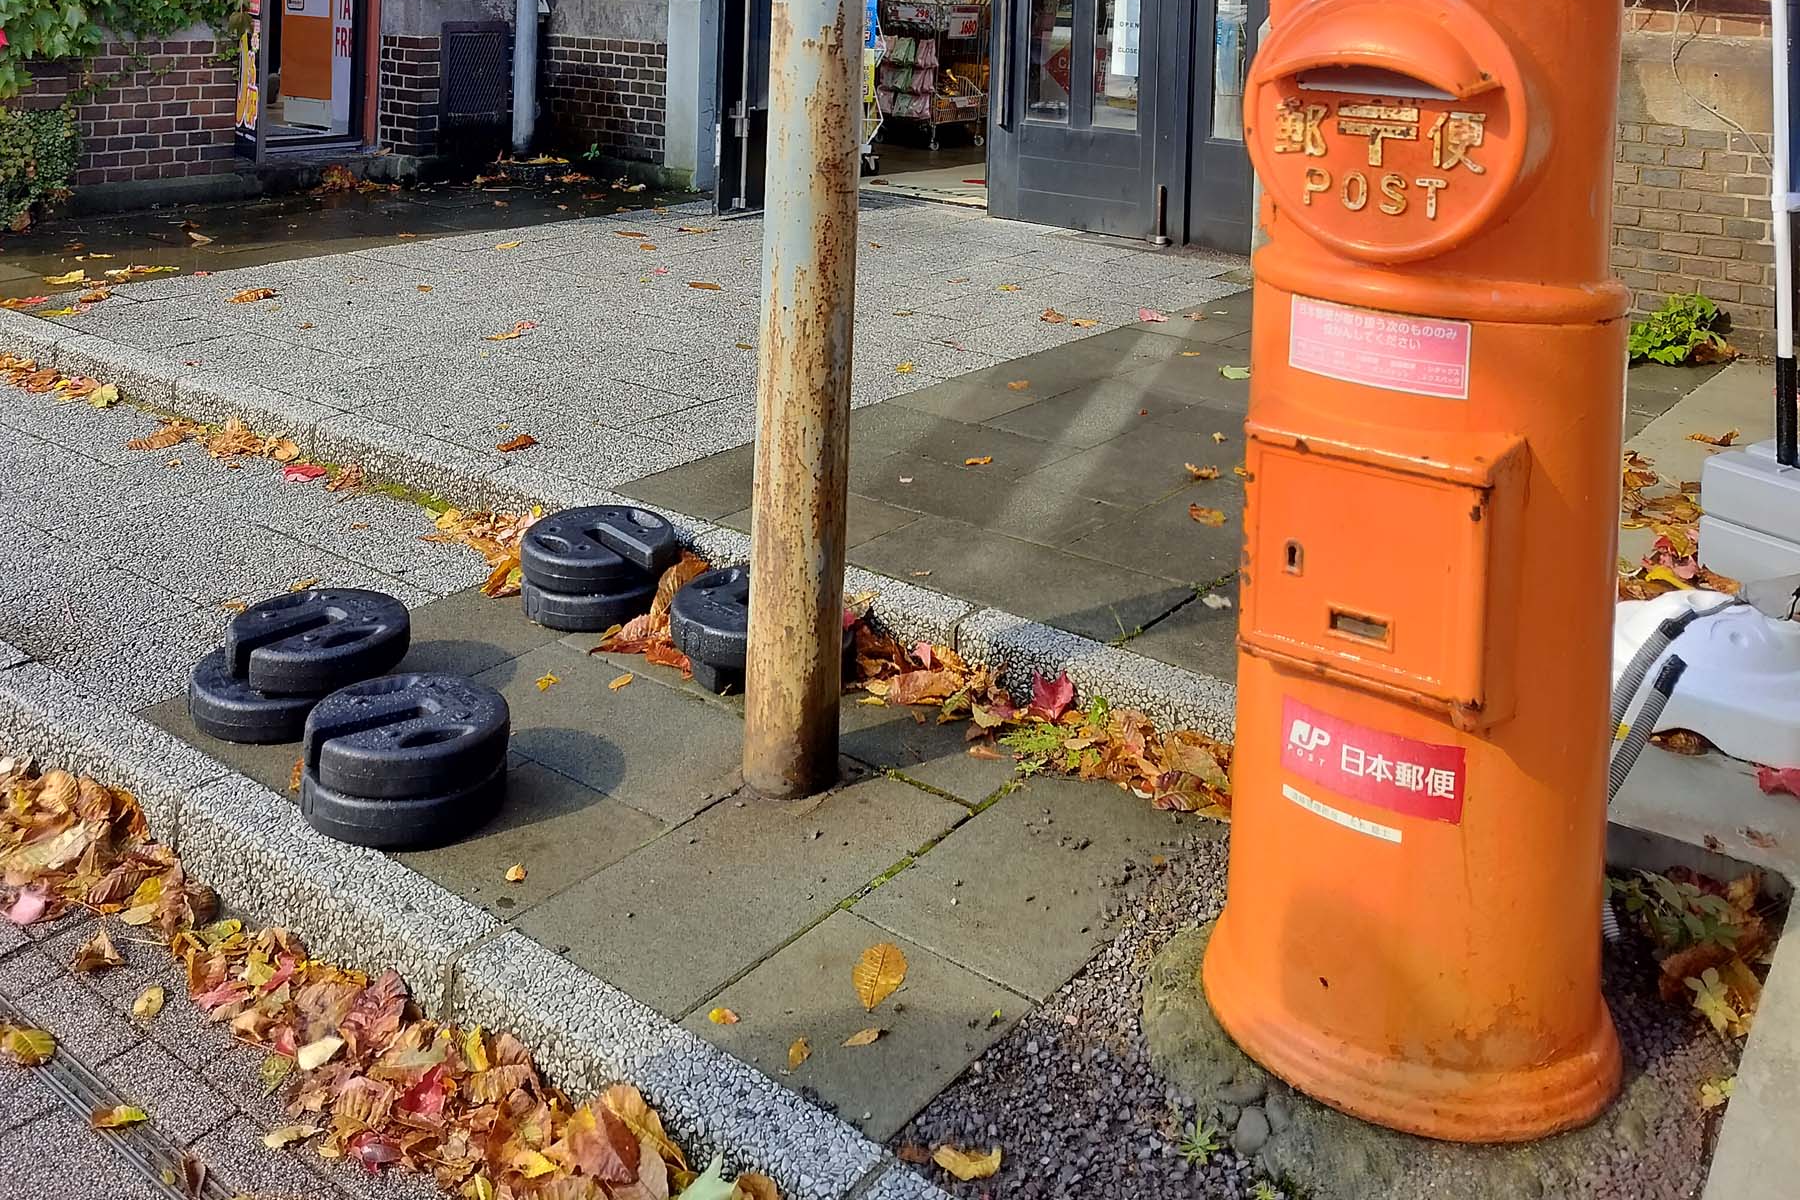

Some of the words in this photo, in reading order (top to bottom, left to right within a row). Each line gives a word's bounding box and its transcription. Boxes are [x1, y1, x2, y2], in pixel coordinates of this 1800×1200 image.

[1303, 166, 1448, 220] POST
[1287, 743, 1326, 767] POST
[1289, 718, 1331, 751] JP
[1341, 743, 1456, 800] 日本郵便
